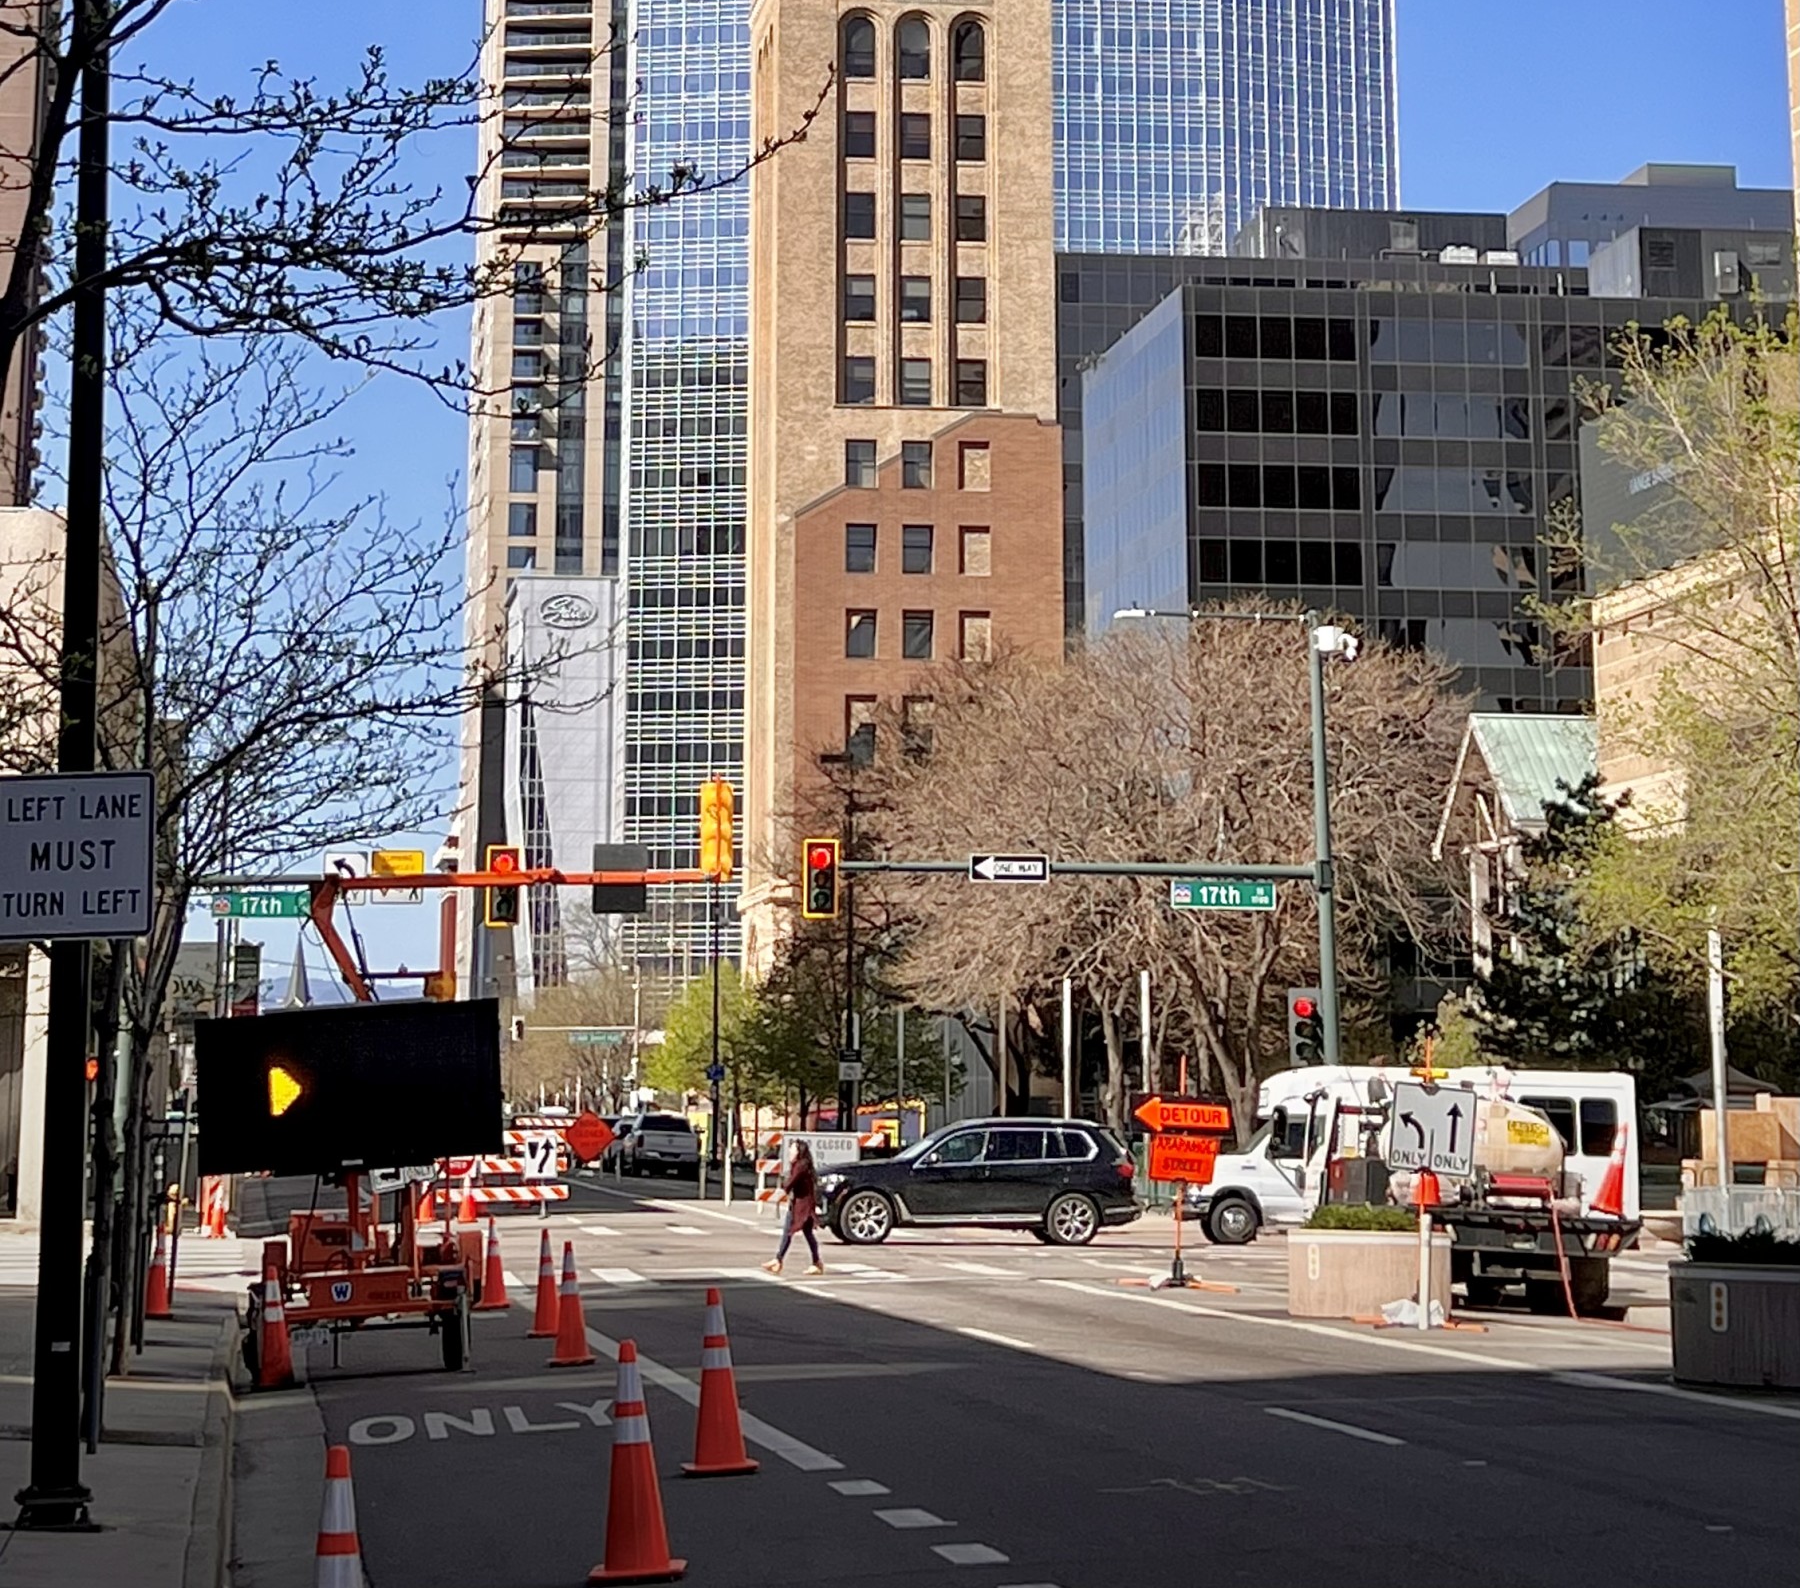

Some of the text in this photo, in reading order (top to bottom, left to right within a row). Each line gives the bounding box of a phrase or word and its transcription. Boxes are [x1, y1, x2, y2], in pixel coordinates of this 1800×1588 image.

[8, 794, 141, 822] LEFT LANE
[30, 839, 116, 872] MUST
[3, 889, 141, 918] TURN LEFT
[1199, 885, 1241, 905] 17th
[239, 897, 282, 915] 17th
[1159, 1107, 1222, 1124] DETOUR
[1391, 1150, 1427, 1165] ONLY
[1434, 1155, 1468, 1169] ONLY
[348, 1398, 614, 1445] ONLY
